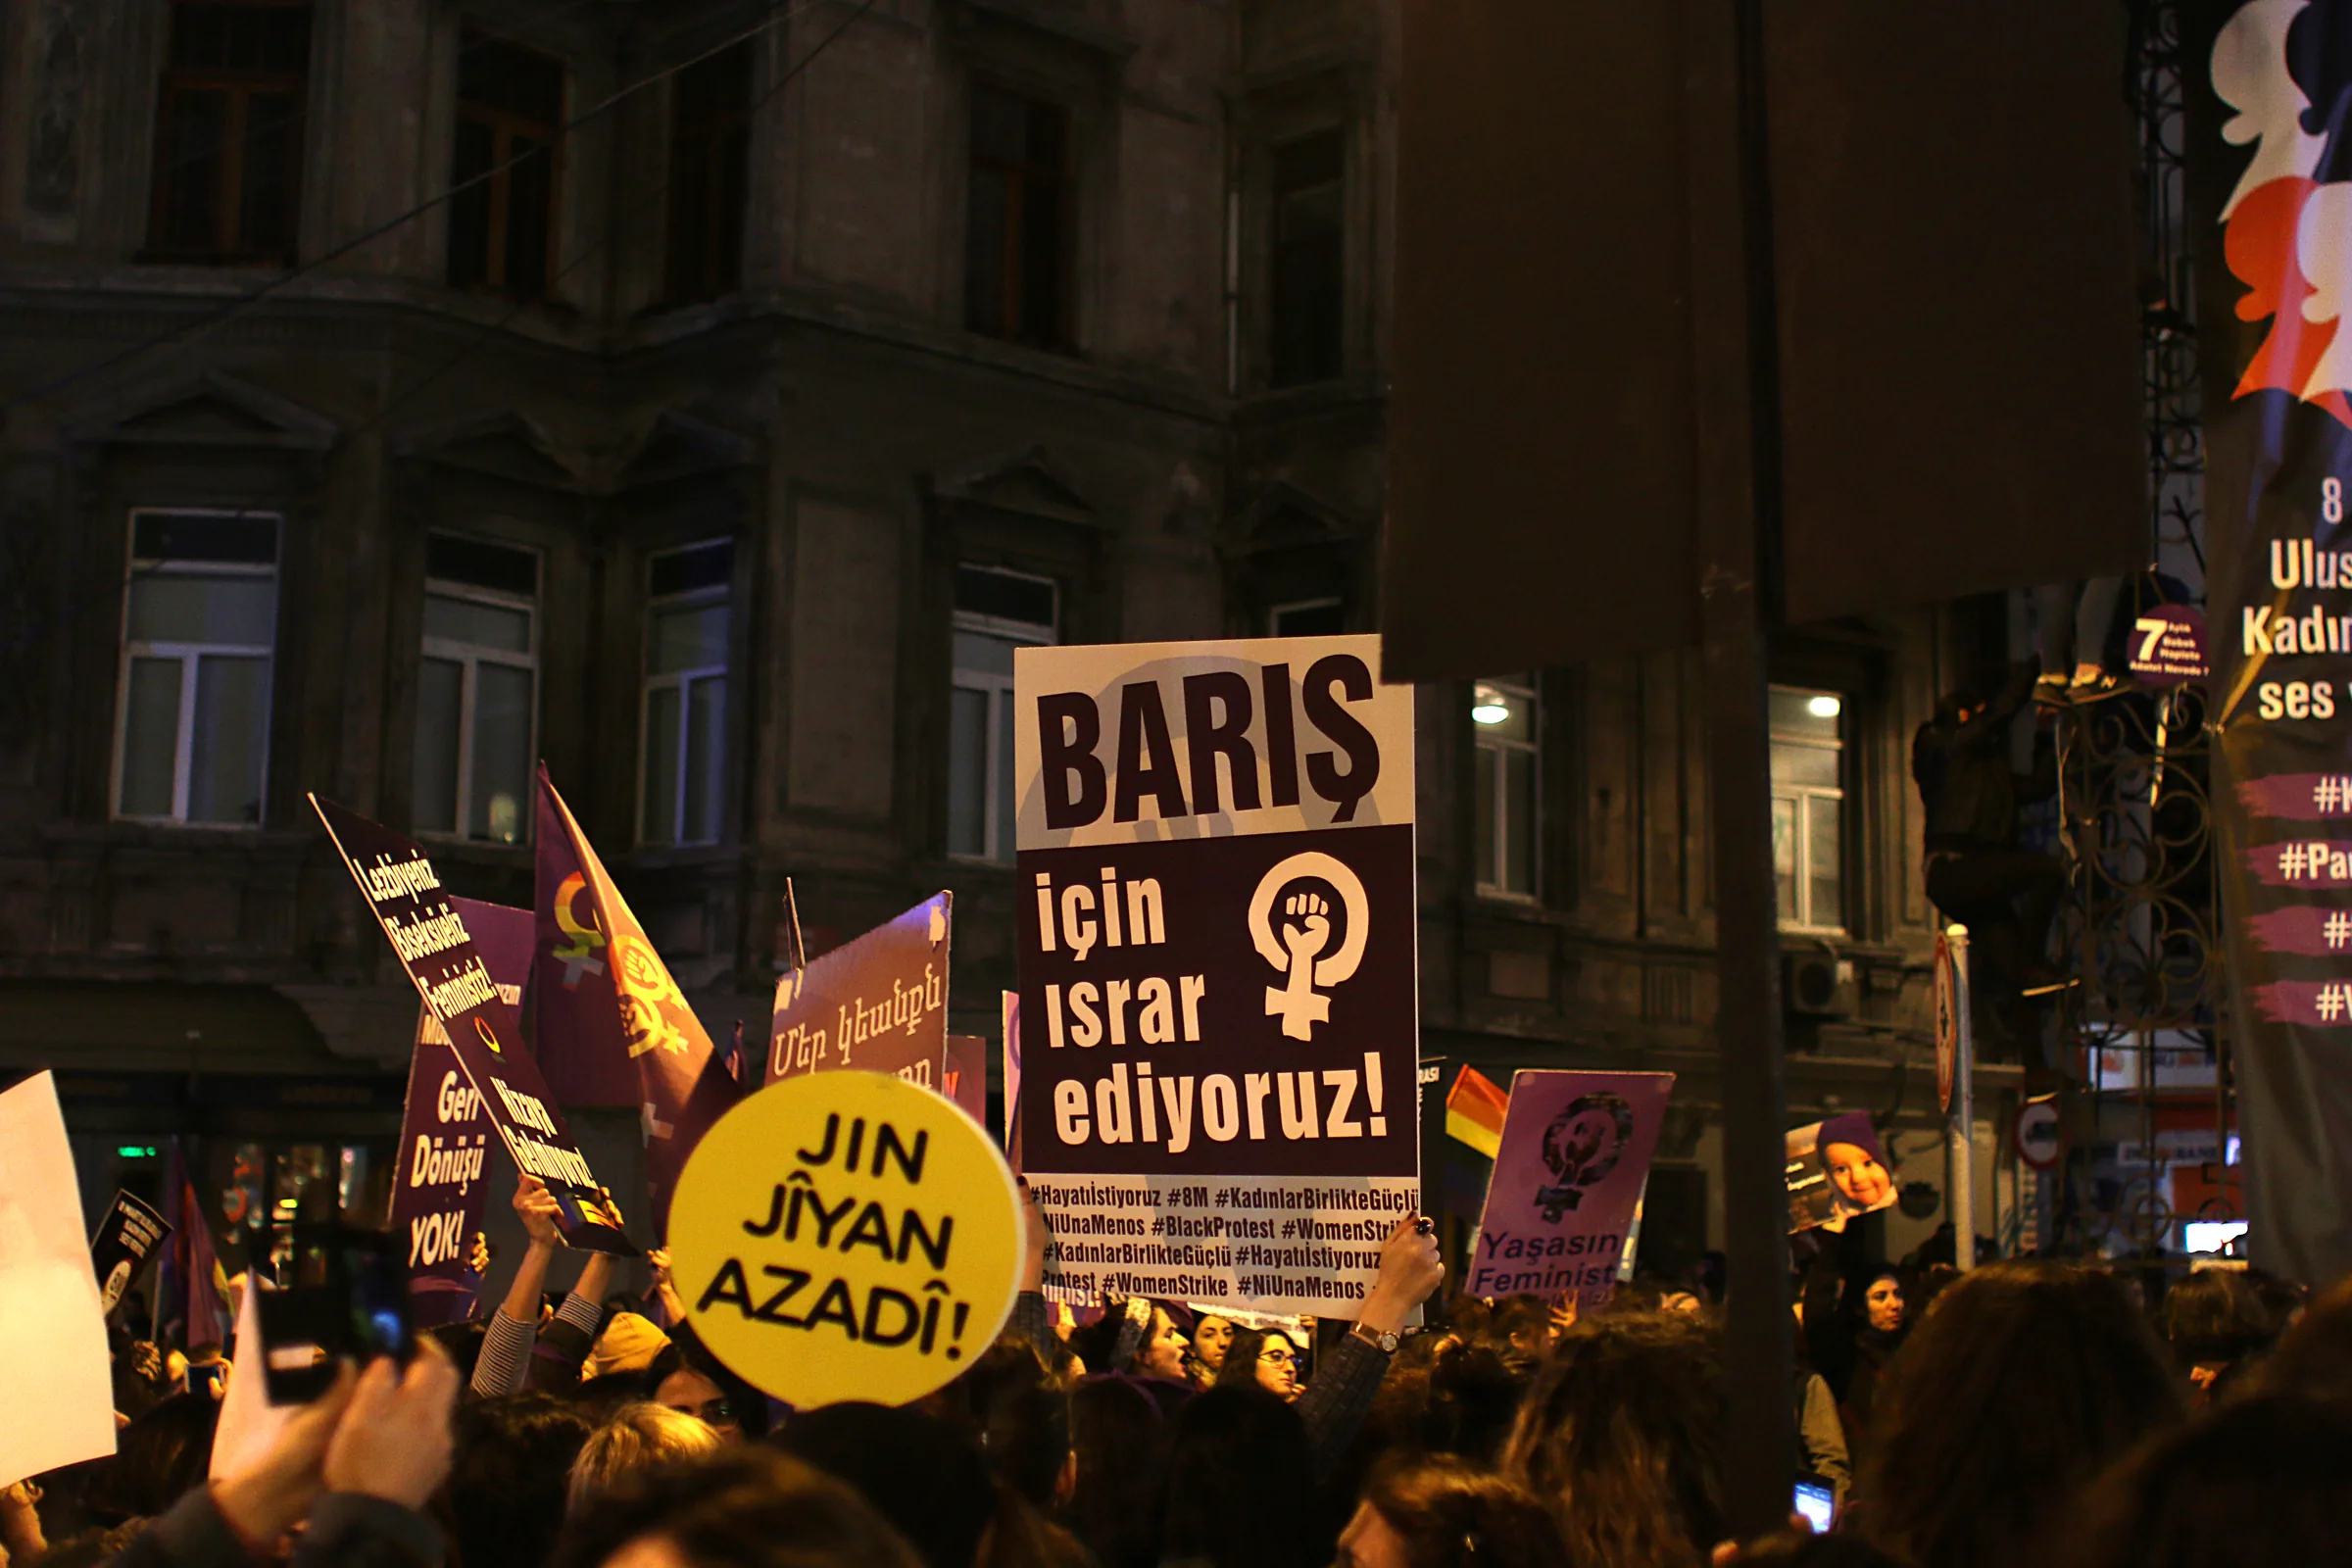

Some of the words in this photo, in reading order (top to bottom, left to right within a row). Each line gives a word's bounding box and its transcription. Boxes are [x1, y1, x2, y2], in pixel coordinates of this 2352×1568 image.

[2322, 476, 2343, 524] 8
[2135, 617, 2169, 662] 7
[2259, 681, 2335, 720] ses
[1037, 654, 1380, 831] BARIŞ
[353, 849, 440, 904] Lezbiyeniz
[2278, 843, 2352, 880] #Pa
[1036, 866, 1166, 961] için
[417, 956, 498, 1021] Feministiz!
[1045, 974, 1206, 1048] ısrar
[490, 1076, 559, 1138] Hizaya
[1054, 1052, 1388, 1153] ediyoruz!
[410, 1134, 486, 1197] Dönüşü
[502, 1124, 599, 1191] Gelmiyoruz!
[797, 1112, 928, 1186] JIN
[742, 1170, 954, 1271] JÎYAN
[1167, 1186, 1209, 1207] #8M
[408, 1209, 466, 1269] YOK!
[1044, 1241, 1231, 1270] #KadınlarBirlikteGüçlü
[1235, 1242, 1381, 1271] #Hayatıİstiyoruz
[1151, 1215, 1276, 1241] #BlackProtest
[1281, 1218, 1401, 1243] #WomenStri
[1482, 1230, 1619, 1265] Yaşasın
[1102, 1272, 1229, 1298] #WomenStrike
[1237, 1275, 1366, 1299] #NiUnaMenos
[1473, 1260, 1618, 1294] Feminist
[696, 1257, 970, 1361] AZADÎ!
